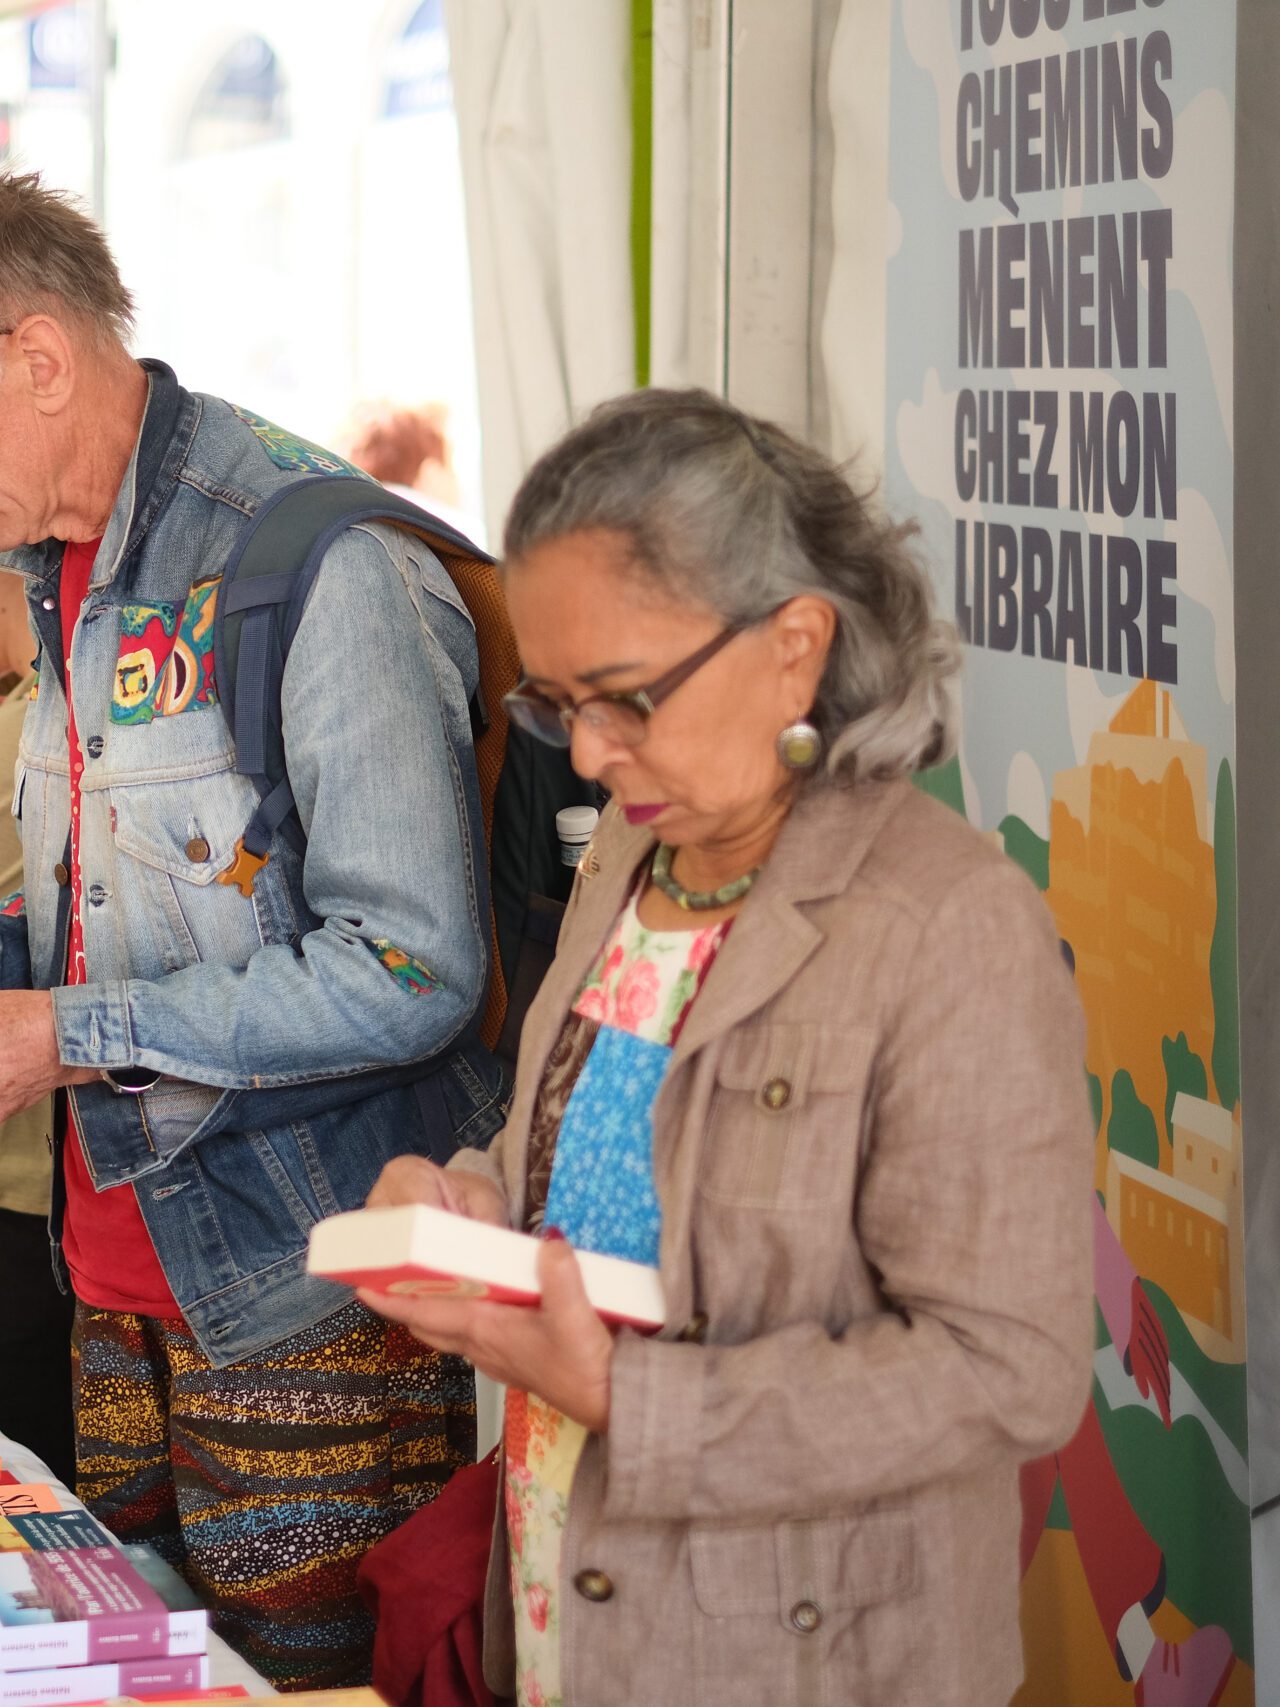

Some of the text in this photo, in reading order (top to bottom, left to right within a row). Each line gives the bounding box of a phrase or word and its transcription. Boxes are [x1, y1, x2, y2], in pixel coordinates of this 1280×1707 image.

[956, 29, 1174, 202] CHEMINS
[958, 197, 1173, 369] MÈNENT
[954, 388, 1177, 521] CHEZ MON
[954, 518, 1178, 685] LIBRAIRE
[55, 1563, 72, 1574] de
[87, 1599, 104, 1614] Par
